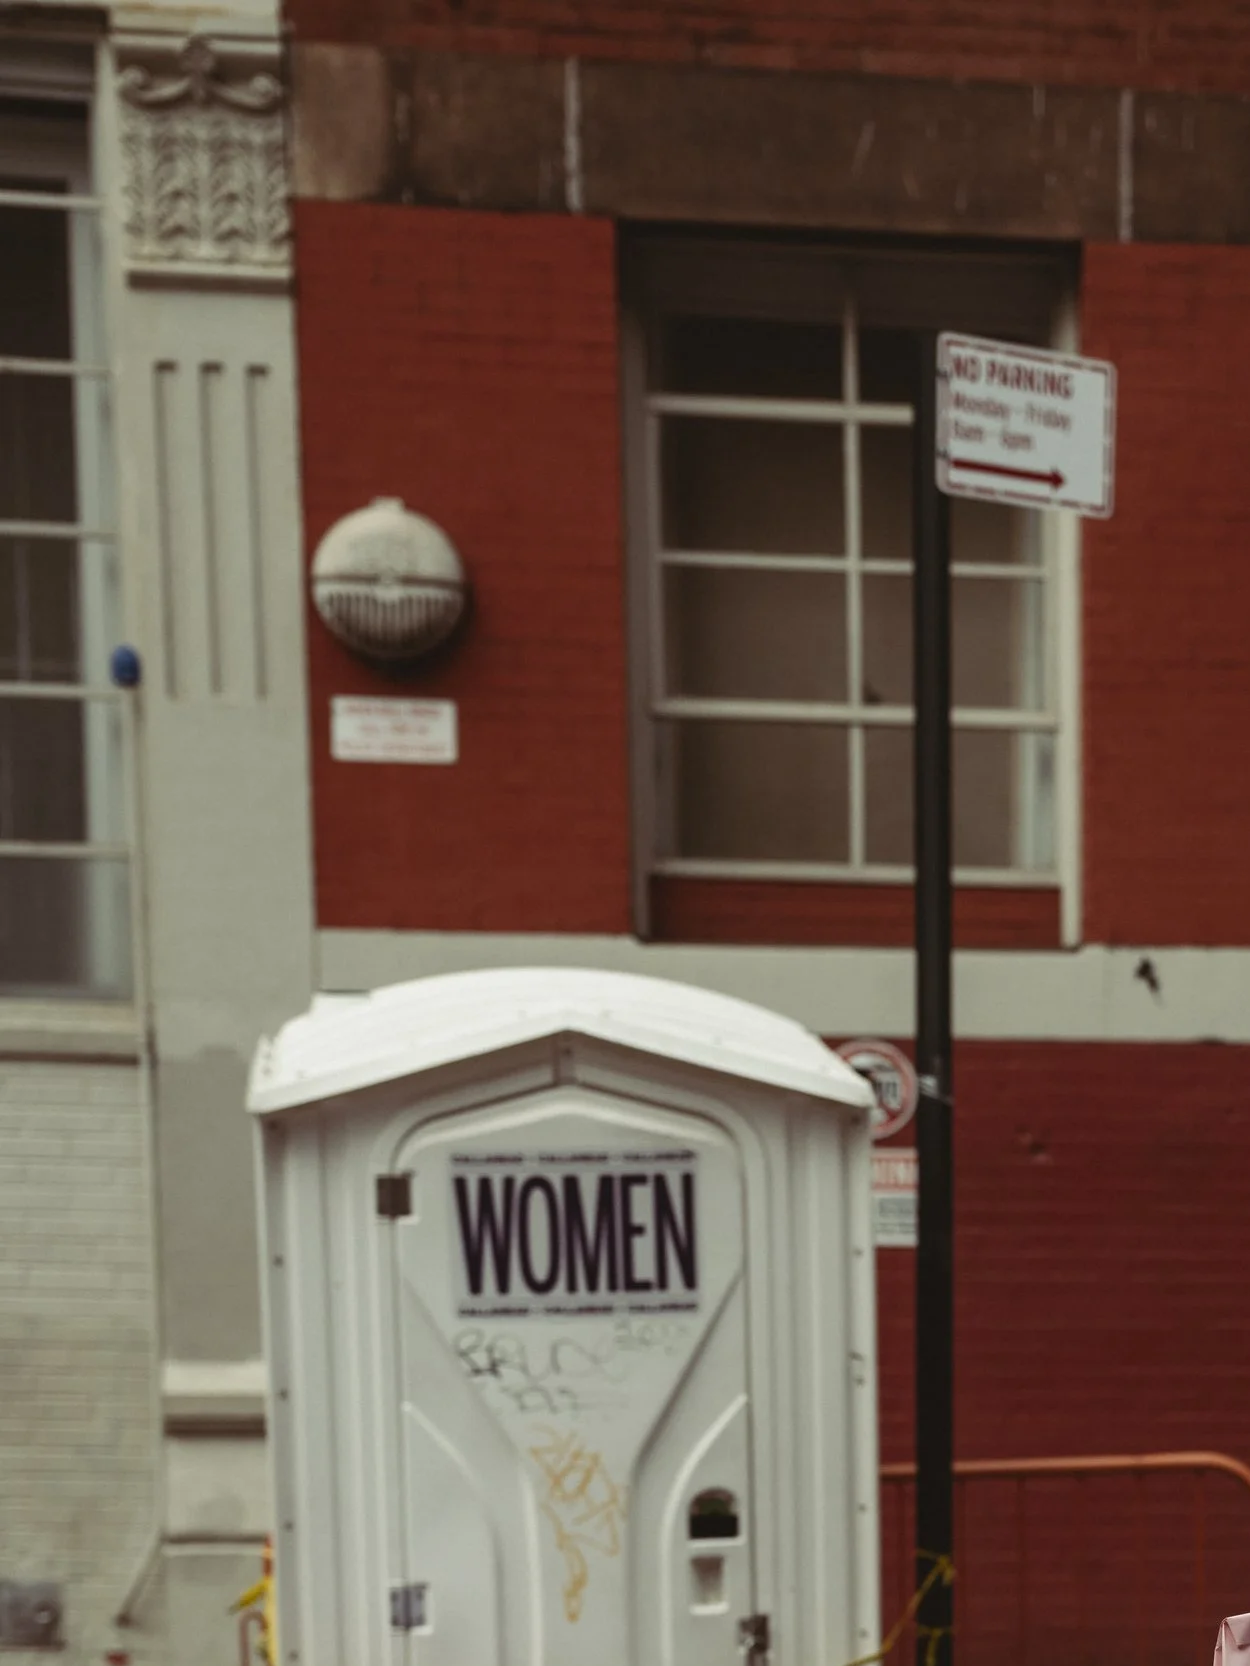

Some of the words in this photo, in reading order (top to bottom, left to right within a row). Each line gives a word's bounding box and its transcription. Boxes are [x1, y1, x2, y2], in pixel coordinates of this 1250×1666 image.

[951, 354, 981, 384] NO
[986, 358, 1074, 399] PARKING
[453, 1172, 698, 1296] WOMEN
